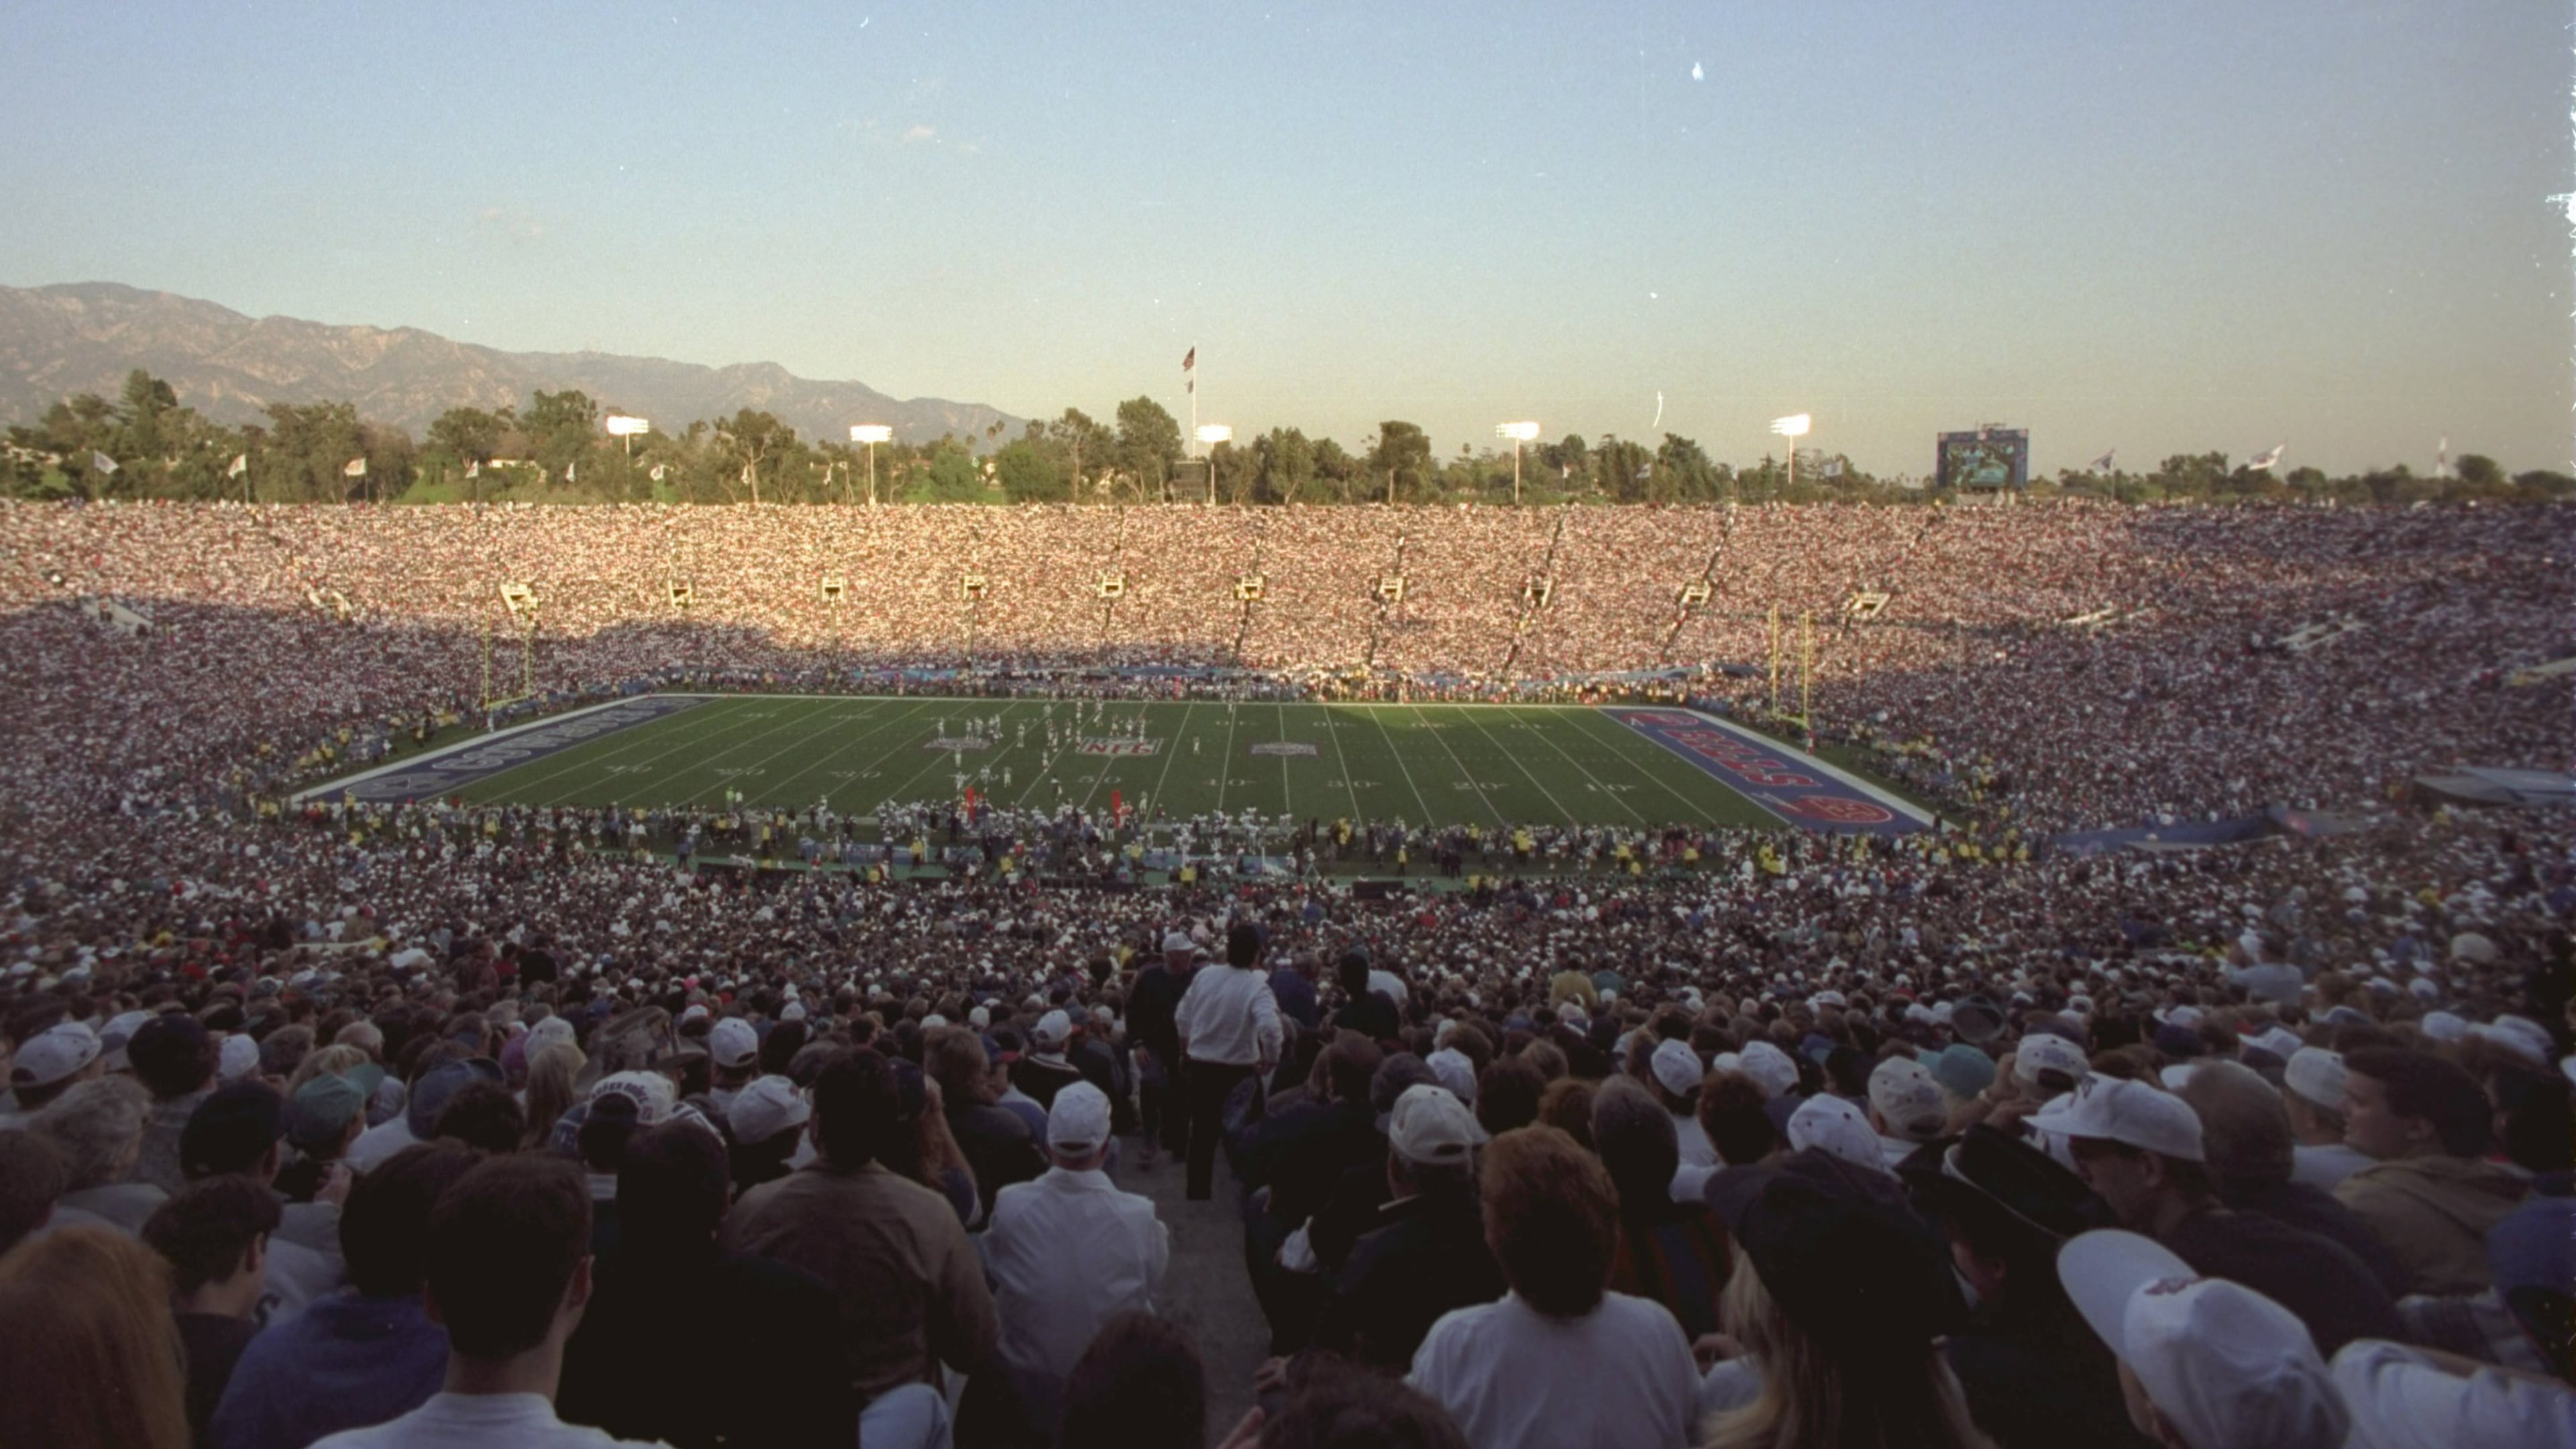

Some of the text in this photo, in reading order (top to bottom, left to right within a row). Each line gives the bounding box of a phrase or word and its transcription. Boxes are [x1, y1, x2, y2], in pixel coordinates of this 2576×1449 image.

[1087, 743, 1150, 755] NFL
[1658, 729, 1823, 786] BILLS
[1078, 775, 1122, 784] 50
